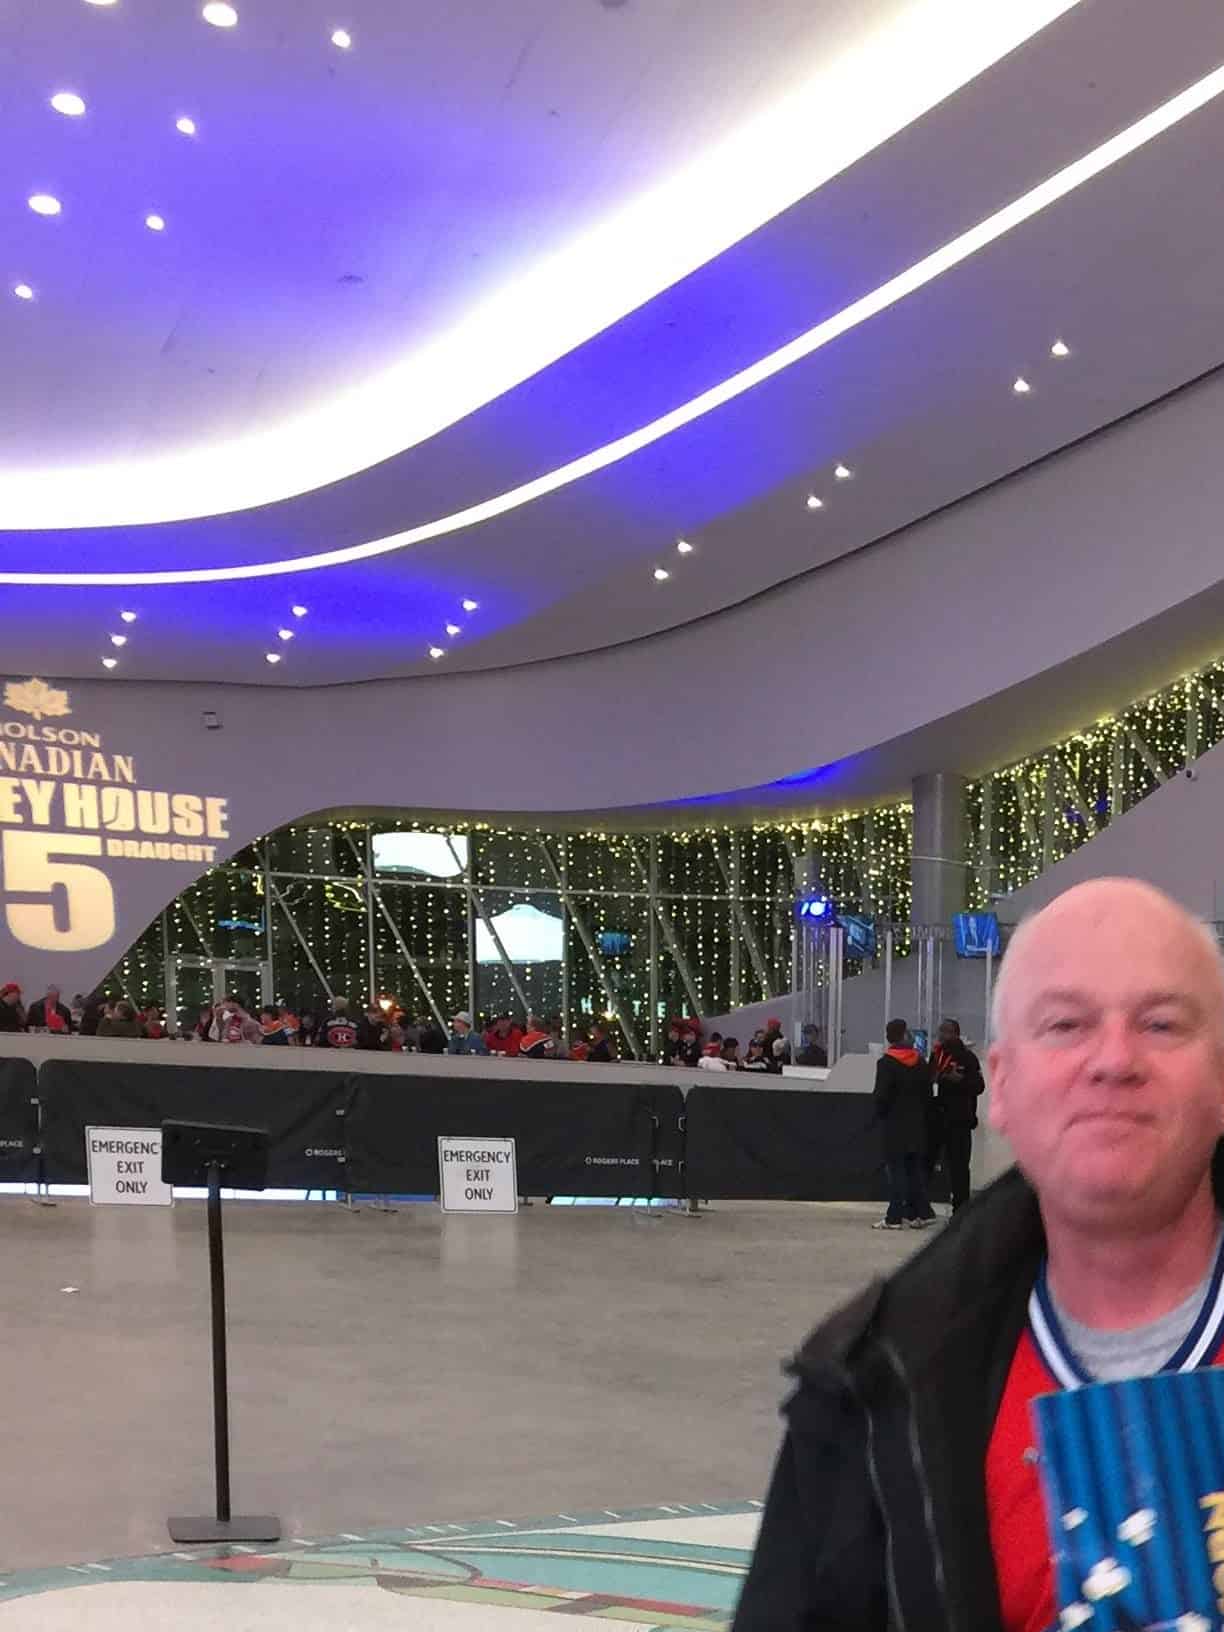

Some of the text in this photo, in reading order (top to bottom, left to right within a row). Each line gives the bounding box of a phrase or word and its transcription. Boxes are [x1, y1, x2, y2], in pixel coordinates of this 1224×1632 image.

[0, 721, 101, 748] OLSON
[63, 782, 230, 839] HOUSE
[106, 838, 217, 862] DRAUGHT
[91, 1139, 161, 1155] EMERGENC
[443, 1149, 511, 1164] EMERGENCY
[116, 1160, 144, 1174] EXIT
[465, 1168, 491, 1183] EXIT
[115, 1180, 148, 1194] ONLY
[464, 1187, 494, 1201] ONLY
